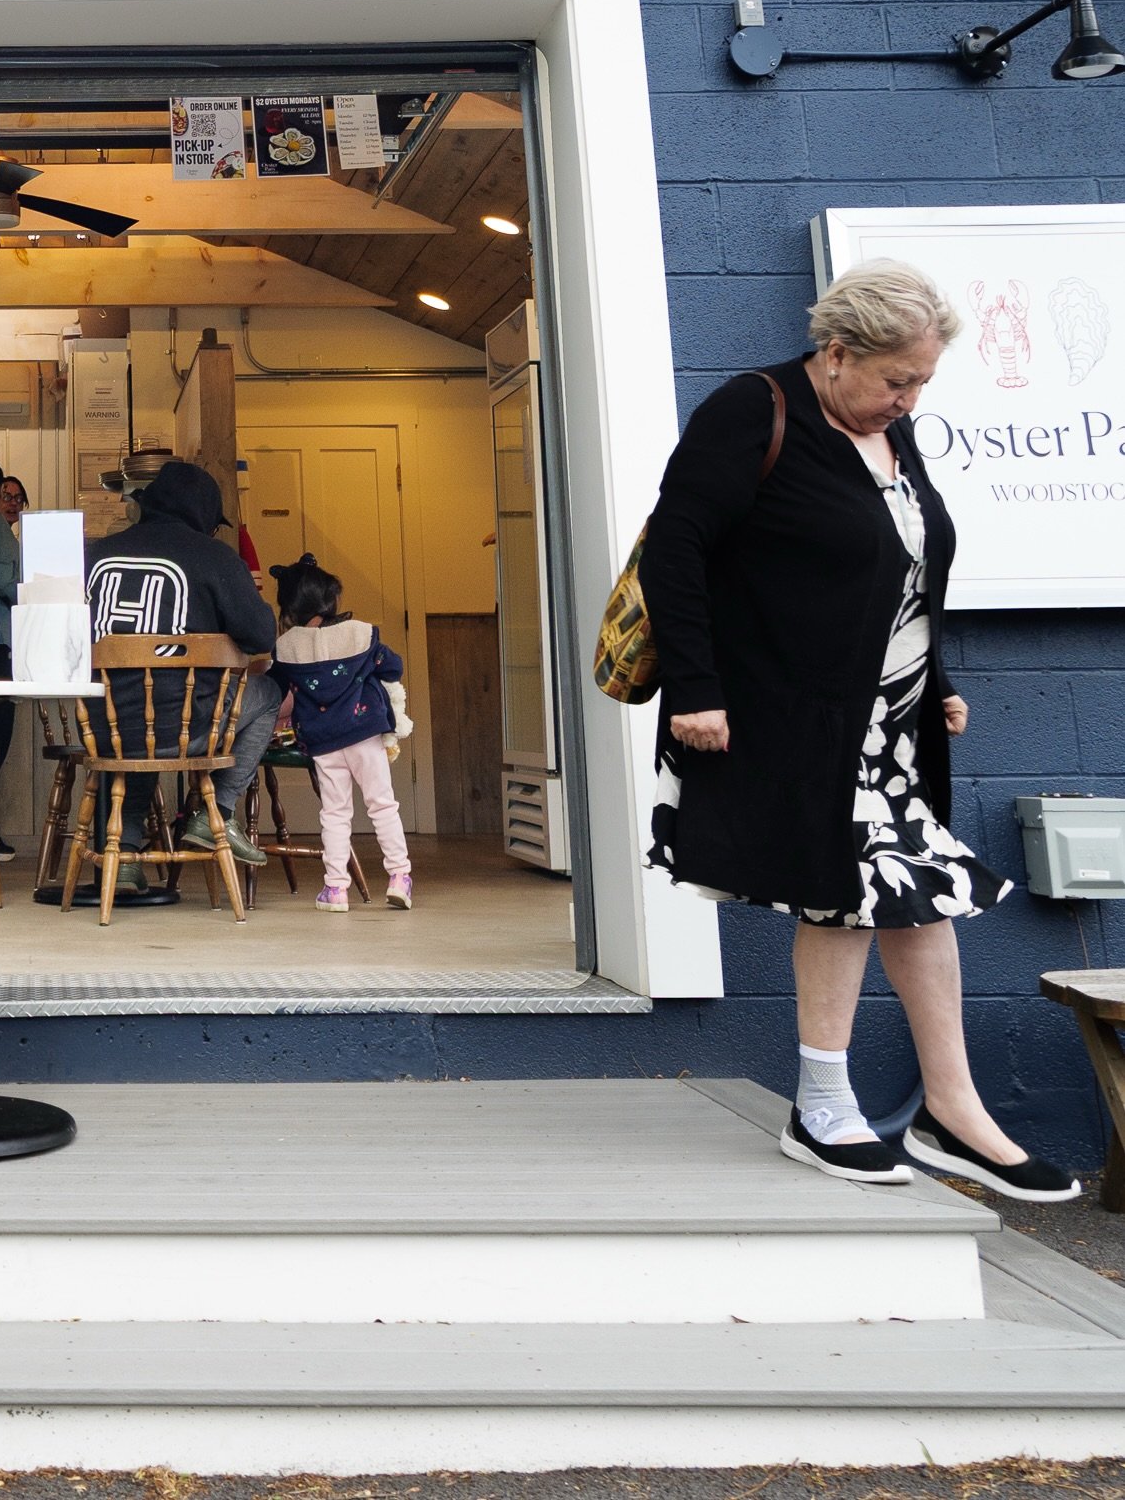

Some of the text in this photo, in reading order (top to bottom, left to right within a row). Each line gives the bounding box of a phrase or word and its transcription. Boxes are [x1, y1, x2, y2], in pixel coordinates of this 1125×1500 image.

[255, 96, 320, 106] $2 OYSTER MONDAYS
[336, 96, 354, 104] Open
[190, 102, 238, 111] ORDER ONLINE
[175, 139, 214, 152] PICK-UP
[175, 153, 215, 165] IN STORE
[84, 411, 121, 419] WARNING
[912, 412, 1070, 471] Oyster
